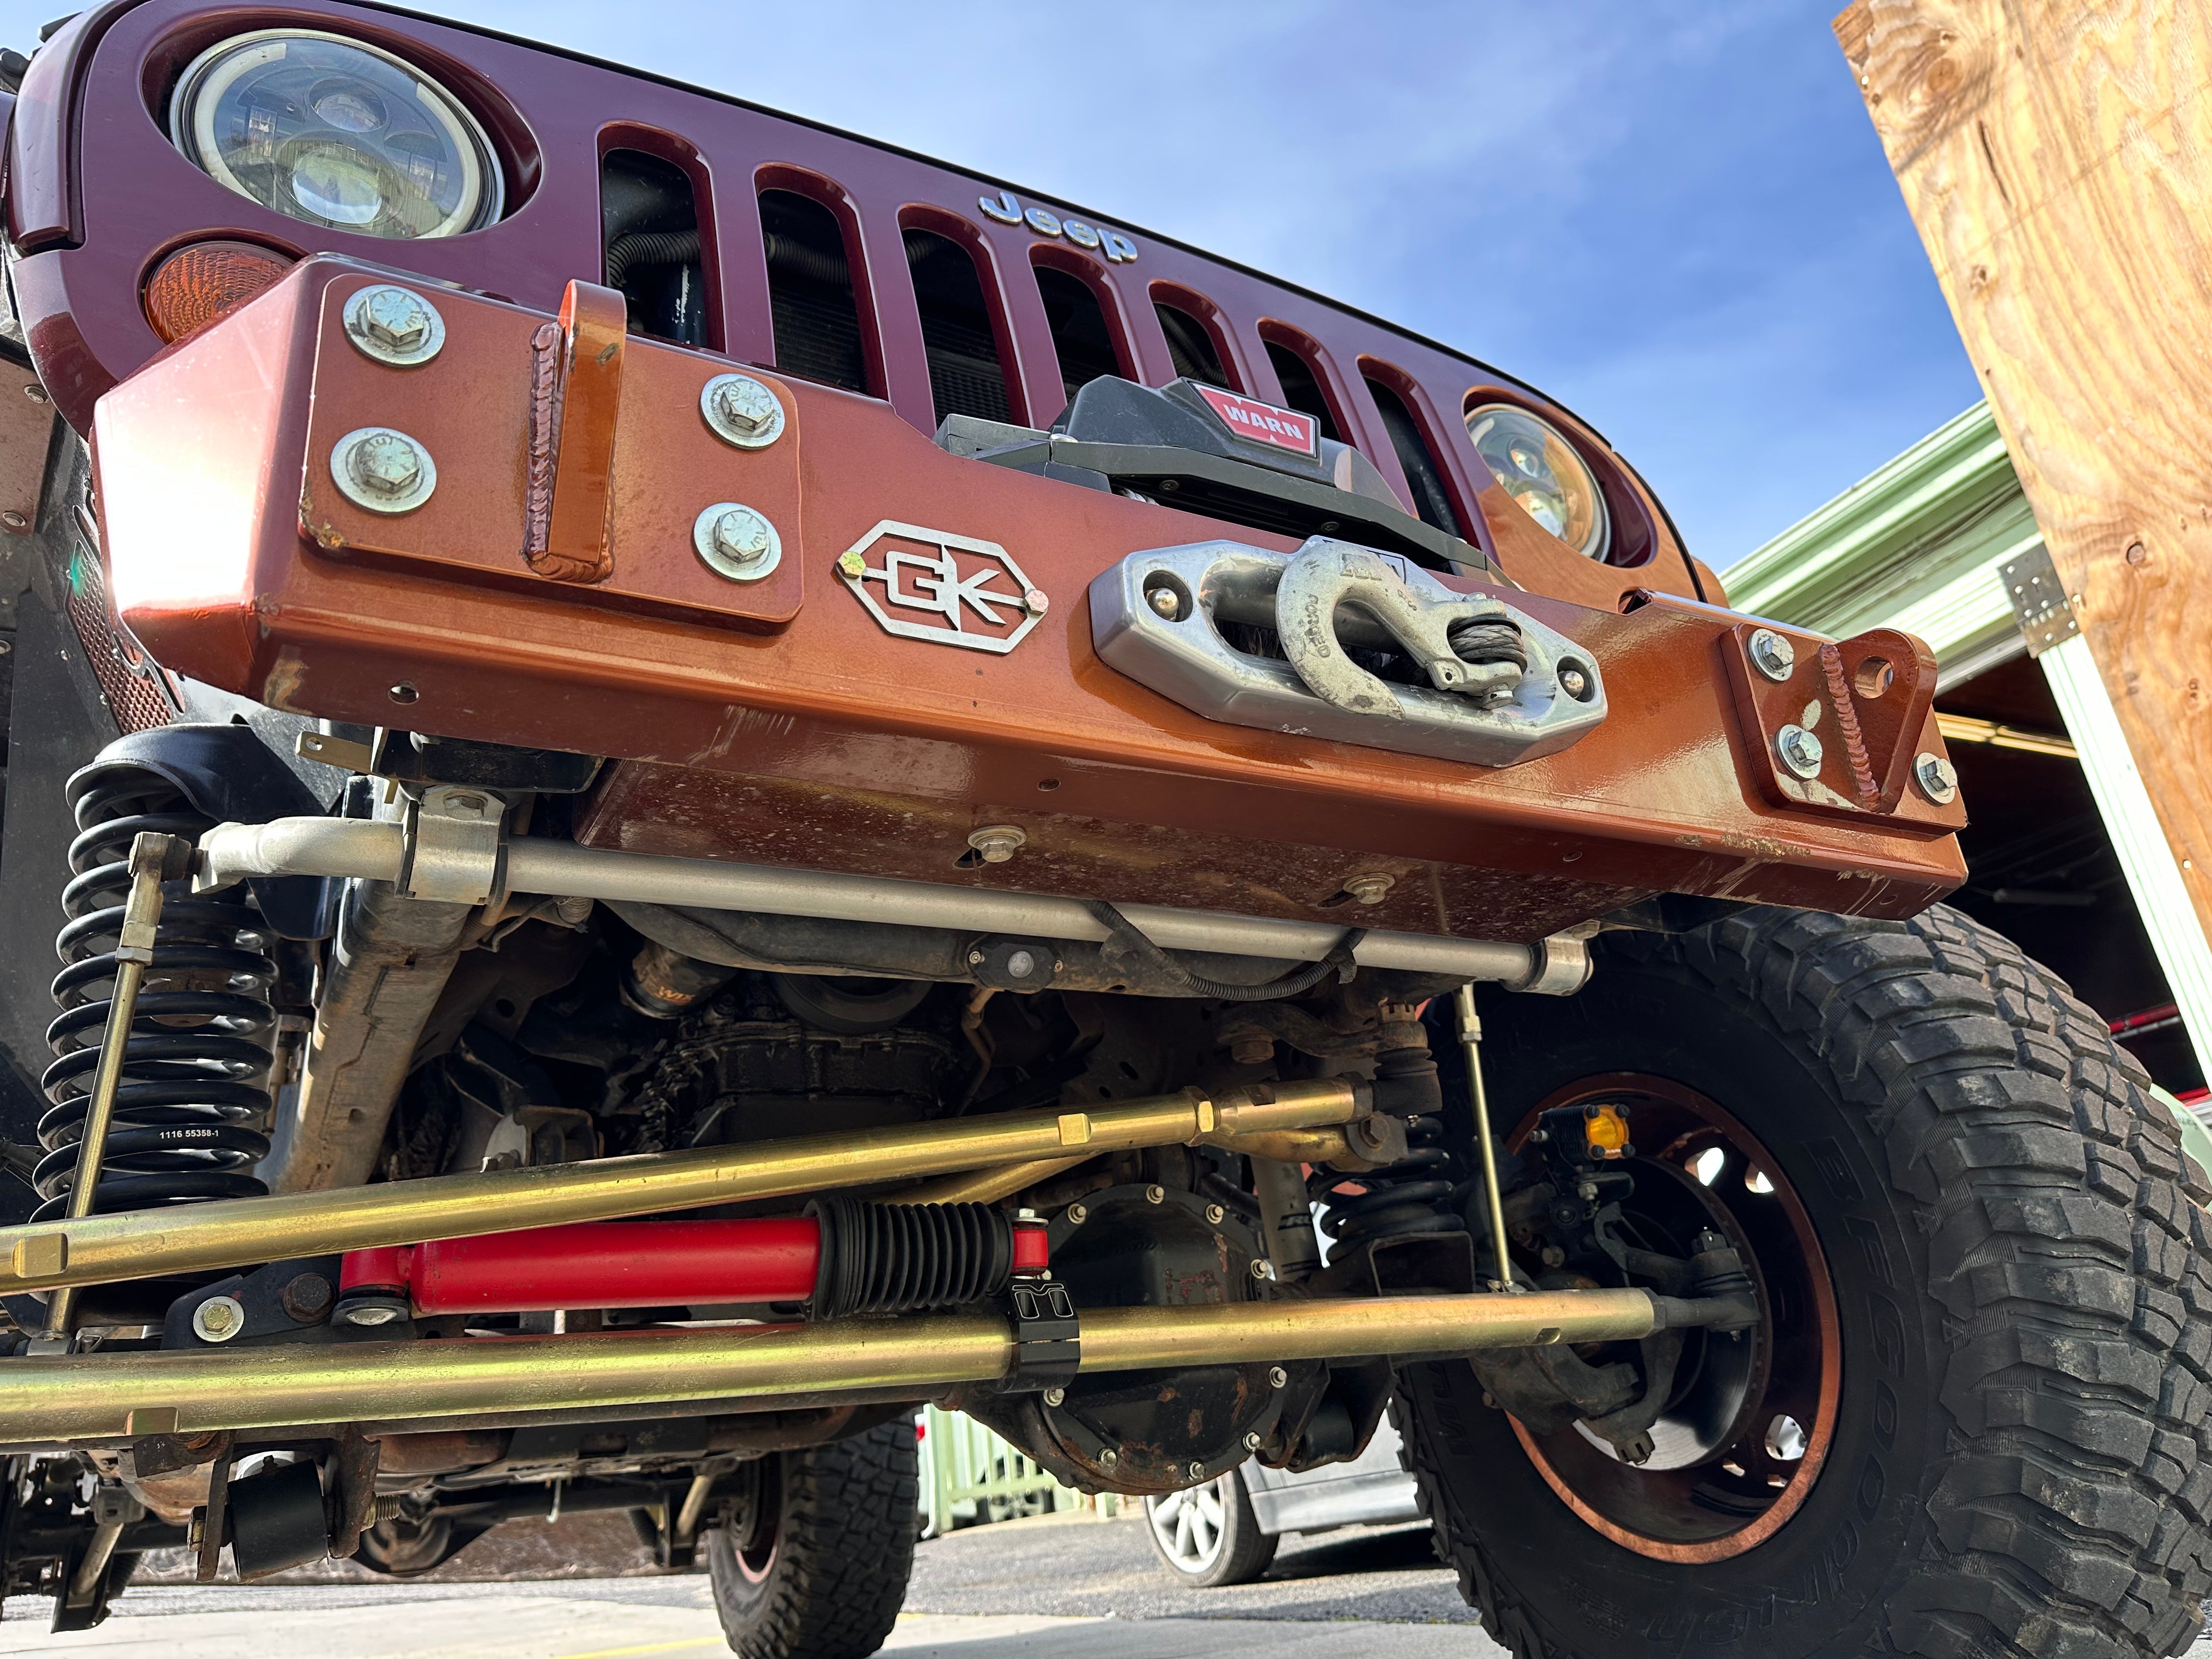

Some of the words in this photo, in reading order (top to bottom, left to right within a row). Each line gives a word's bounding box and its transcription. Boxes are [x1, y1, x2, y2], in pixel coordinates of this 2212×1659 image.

[978, 191, 1137, 262] Jeep
[1223, 403, 1304, 440] WARN
[159, 1130, 183, 1139] 1116
[185, 1129, 219, 1138] 55358-1
